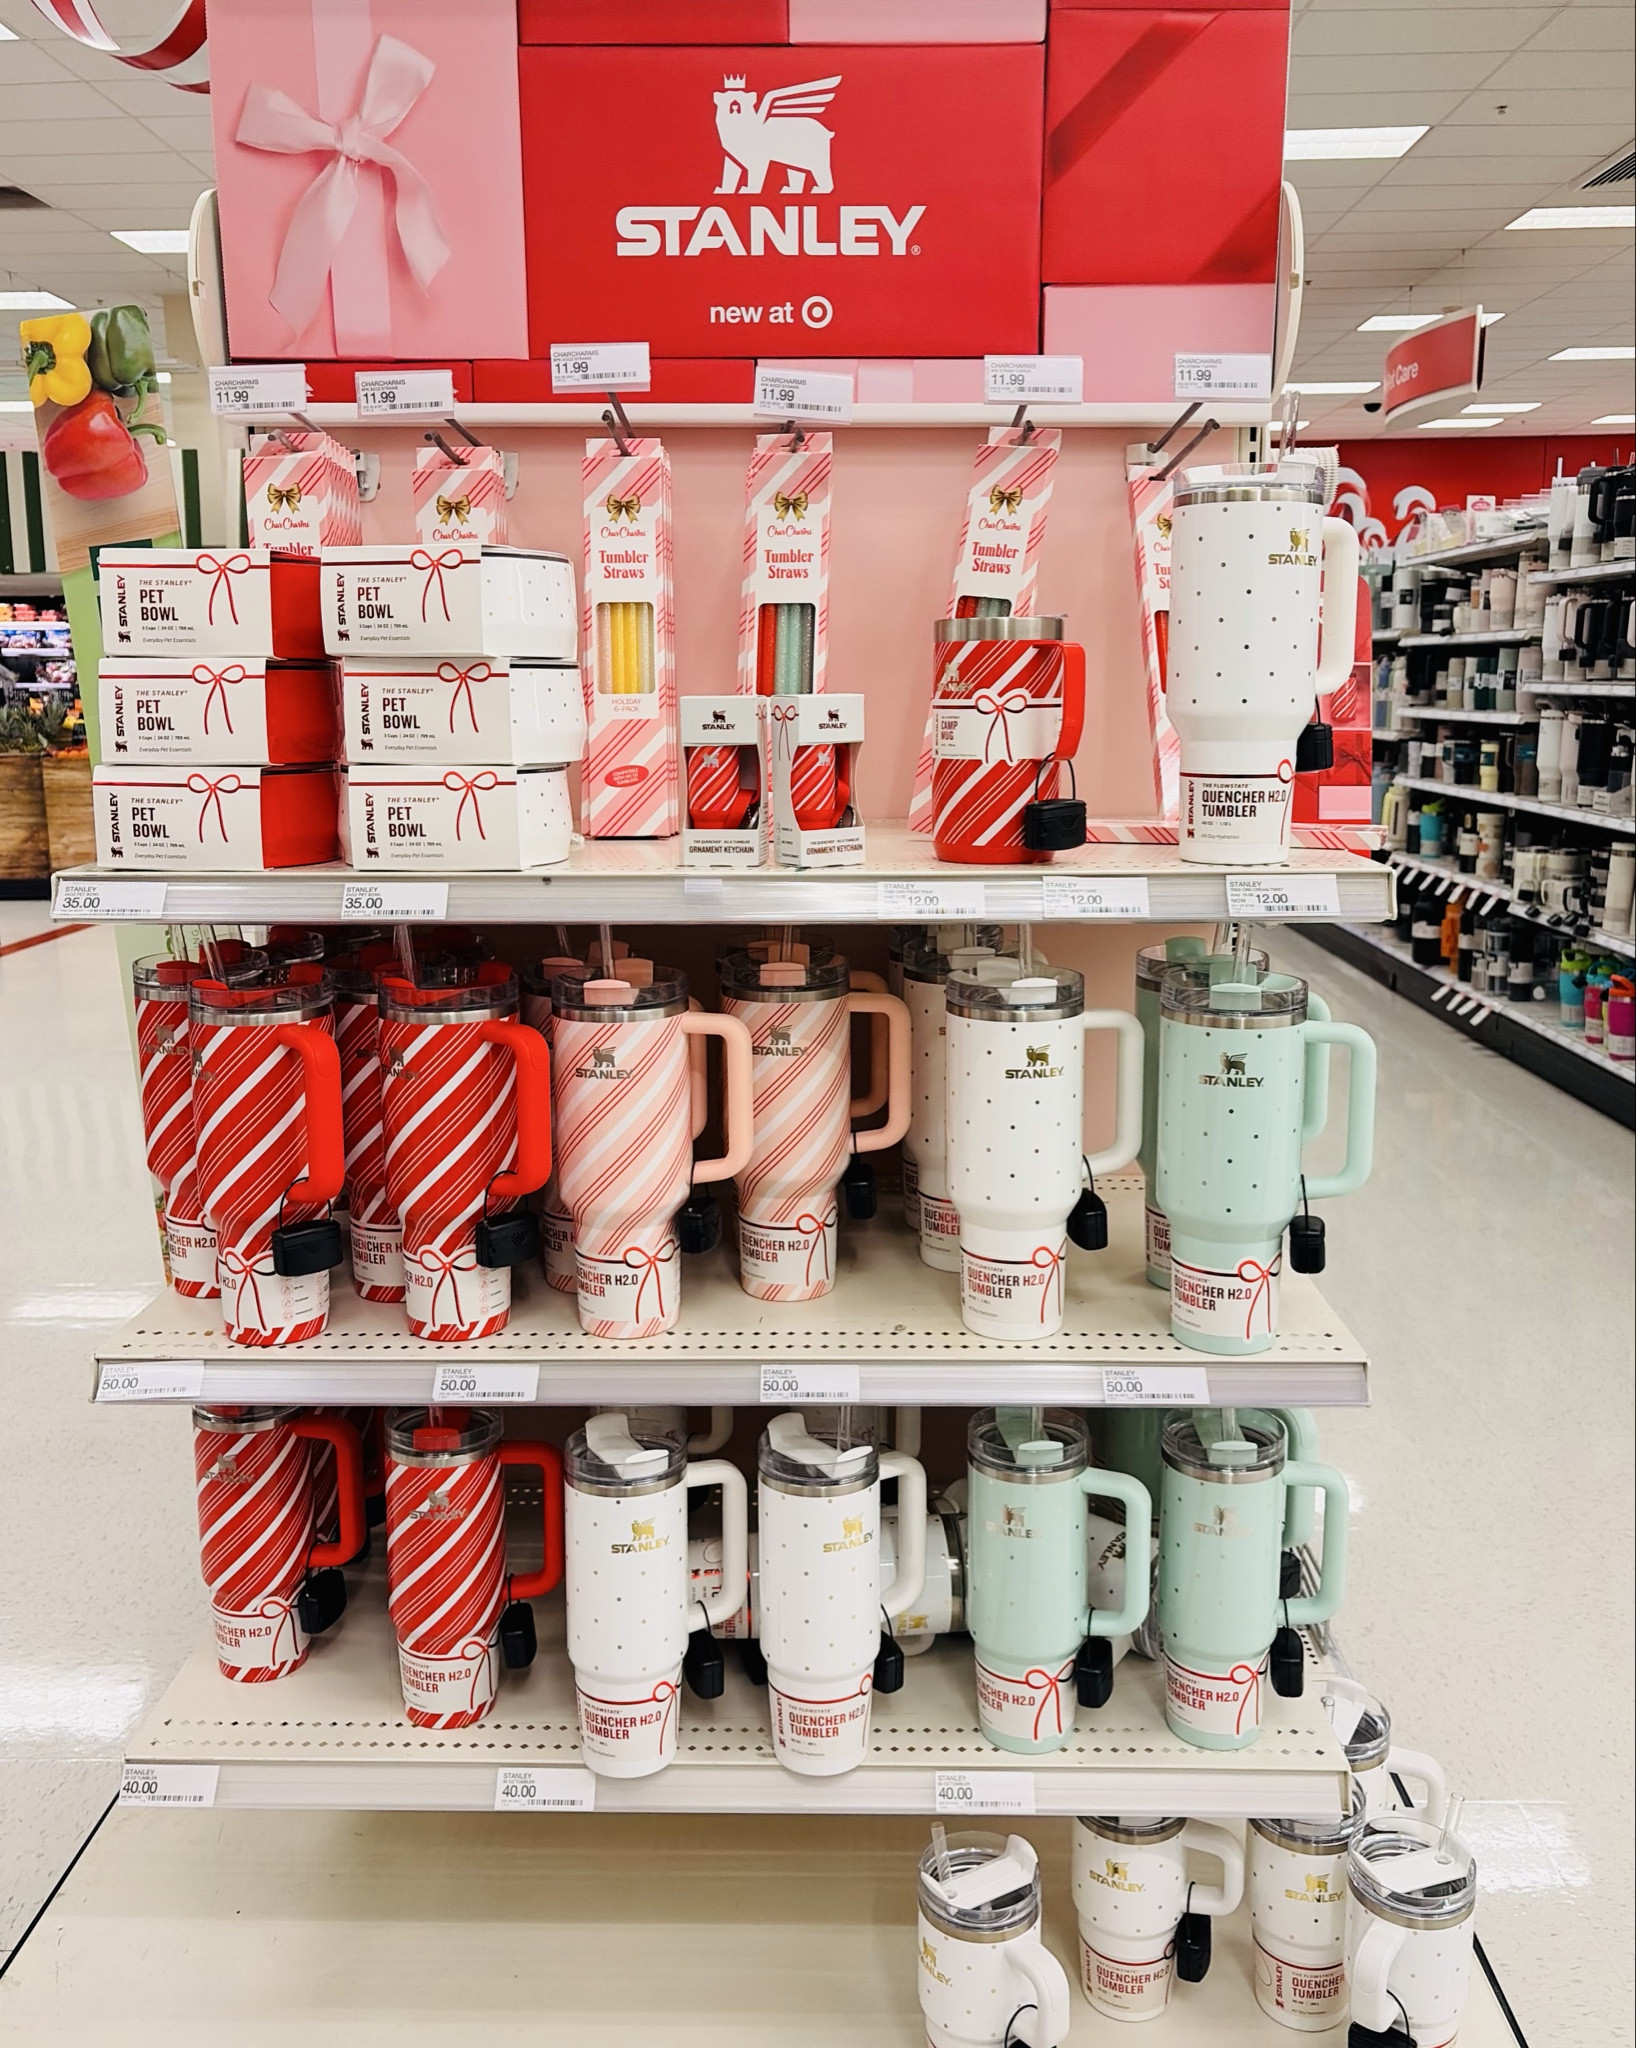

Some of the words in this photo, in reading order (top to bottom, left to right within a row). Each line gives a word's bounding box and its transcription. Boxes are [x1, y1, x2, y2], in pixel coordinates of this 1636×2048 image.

[615, 206, 927, 255] STANLEY
[710, 305, 763, 323] new
[769, 302, 794, 323] at
[553, 350, 599, 358] CHARCHARMS
[555, 362, 588, 374] 11.99
[761, 376, 806, 386] CHARCHARMS
[992, 374, 1024, 385] 11.99
[1179, 370, 1211, 380] 11.99
[361, 379, 406, 387] CHARCHARMS
[217, 391, 248, 402] 11.99
[363, 391, 395, 403] 11.99
[762, 388, 794, 401] 11.99
[972, 542, 1019, 558] Tumbler
[599, 550, 649, 564] Tumbler
[765, 550, 814, 564] Tumbler
[1268, 554, 1317, 566] STANLEY
[604, 566, 645, 579] Straws
[768, 565, 808, 579] Straws
[972, 558, 1011, 574] Straws
[117, 575, 128, 626] STANLEY
[140, 590, 164, 603] PET
[337, 573, 346, 625] STANLEY
[357, 587, 380, 601] PET
[141, 607, 178, 621] BOWL
[358, 604, 394, 619] BOWL
[115, 686, 124, 737] STANLEY
[137, 700, 160, 713] PET
[361, 683, 370, 735] STANLEY
[383, 698, 406, 712] PET
[138, 717, 174, 731] BOWL
[383, 715, 420, 729] BOWL
[941, 721, 958, 730] CAMP
[941, 731, 953, 740] MUG
[1202, 790, 1264, 803] QUENCHER
[1268, 790, 1285, 802] H2.0
[132, 807, 155, 821] PET
[388, 807, 411, 820] PET
[1202, 804, 1256, 817] TUMBLER
[110, 793, 120, 843] STANLEY
[366, 793, 376, 843] STANLEY
[133, 824, 169, 838] BOWL
[389, 824, 426, 837] BOWL
[807, 846, 835, 855] ORNAMENT
[837, 843, 863, 853] KEYCHAIN
[63, 897, 100, 908] 35.00
[345, 898, 382, 908] 35.00
[908, 896, 939, 905] 12.00
[1071, 895, 1102, 904] 12.00
[1256, 894, 1288, 903] 12.00
[752, 1046, 807, 1057] STANLEY
[575, 1068, 633, 1080] STANLEY
[1005, 1066, 1063, 1079] STANLEY
[1199, 1074, 1263, 1088] STANLEY
[195, 1237, 216, 1248] H2.0
[788, 1239, 809, 1250] H2.0
[415, 1274, 433, 1288] H2.0
[615, 1274, 638, 1285] H2.0
[968, 1267, 1020, 1286] QUENCHER
[1023, 1274, 1044, 1286] H2.0
[968, 1280, 1012, 1299] TUMBLER
[1174, 1275, 1224, 1299] QUENCHER
[1228, 1288, 1251, 1299] H2.0
[1174, 1288, 1216, 1311] TUMBLER
[102, 1378, 138, 1389] 50.00
[440, 1380, 476, 1390] 50.00
[763, 1380, 798, 1391] 50.00
[1107, 1381, 1142, 1392] 50.00
[611, 1535, 669, 1554] STANLEY
[823, 1530, 873, 1553] STANLEY
[249, 1626, 271, 1637] H2.0
[449, 1668, 471, 1681] H2.0
[1012, 1695, 1035, 1706] H2.0
[1216, 1692, 1238, 1702] H2.0
[585, 1710, 637, 1728] QUENCHER
[640, 1711, 661, 1725] H2.0
[789, 1712, 846, 1726] QUENCHER
[849, 1704, 865, 1722] H2.0
[586, 1723, 629, 1739] TUMBLER
[790, 1723, 839, 1738] TUMBLER
[123, 1781, 157, 1793] 40.00
[502, 1785, 536, 1797] 40.00
[939, 1788, 972, 1799] 40.00
[1090, 1870, 1144, 1892] STANLEY
[1285, 1890, 1343, 1902] STANLEY
[1097, 1965, 1150, 1983] QUENCHER
[1098, 1975, 1144, 1994] TUMBLER
[1292, 1986, 1339, 1999] TUMBLER
